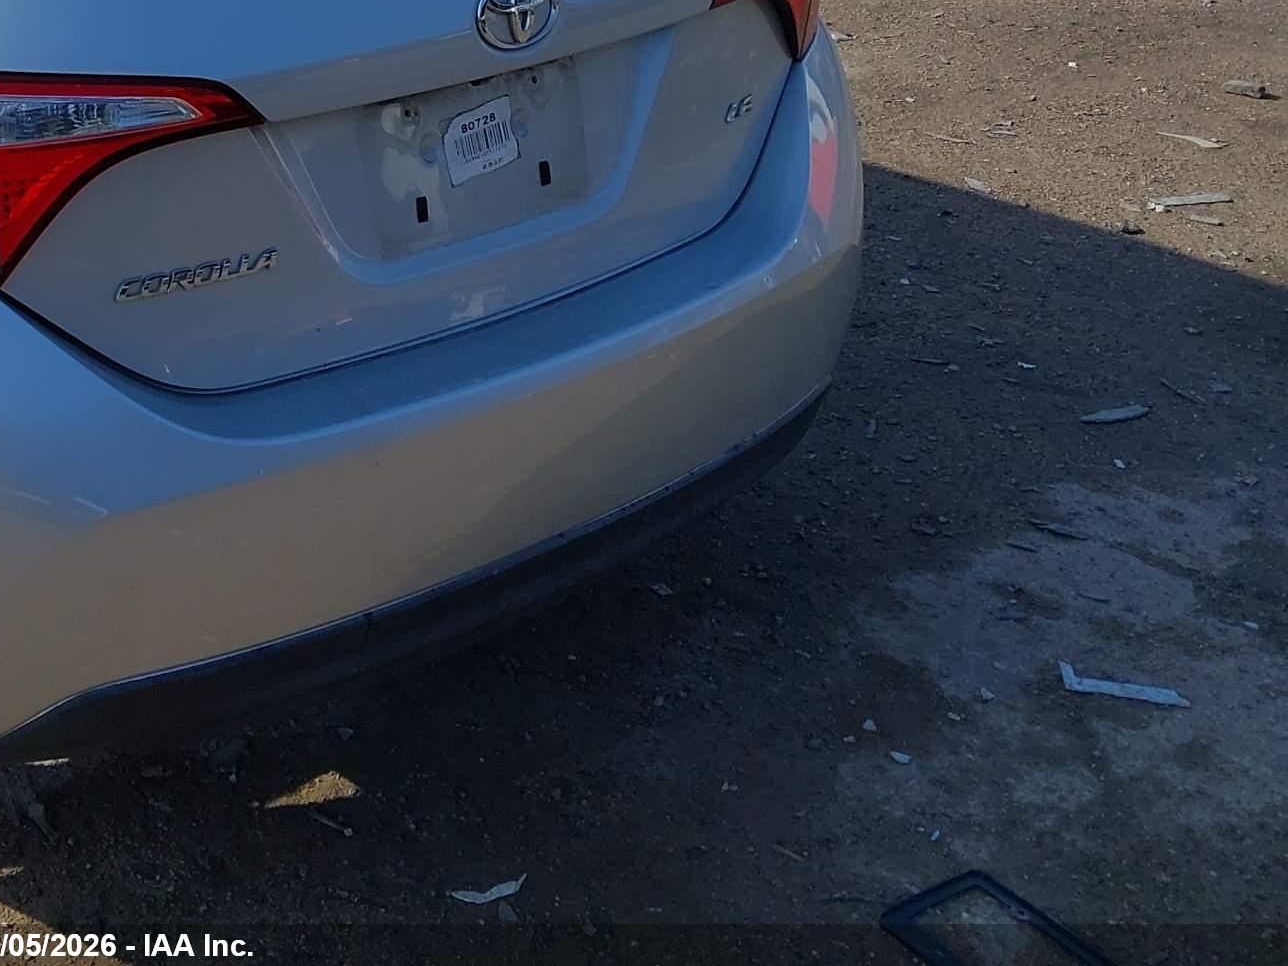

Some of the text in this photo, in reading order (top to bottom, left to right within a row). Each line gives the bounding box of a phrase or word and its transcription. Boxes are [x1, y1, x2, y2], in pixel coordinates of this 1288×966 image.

[461, 112, 497, 133] 80728
[725, 94, 752, 123] LE
[114, 247, 277, 303] COROLLA
